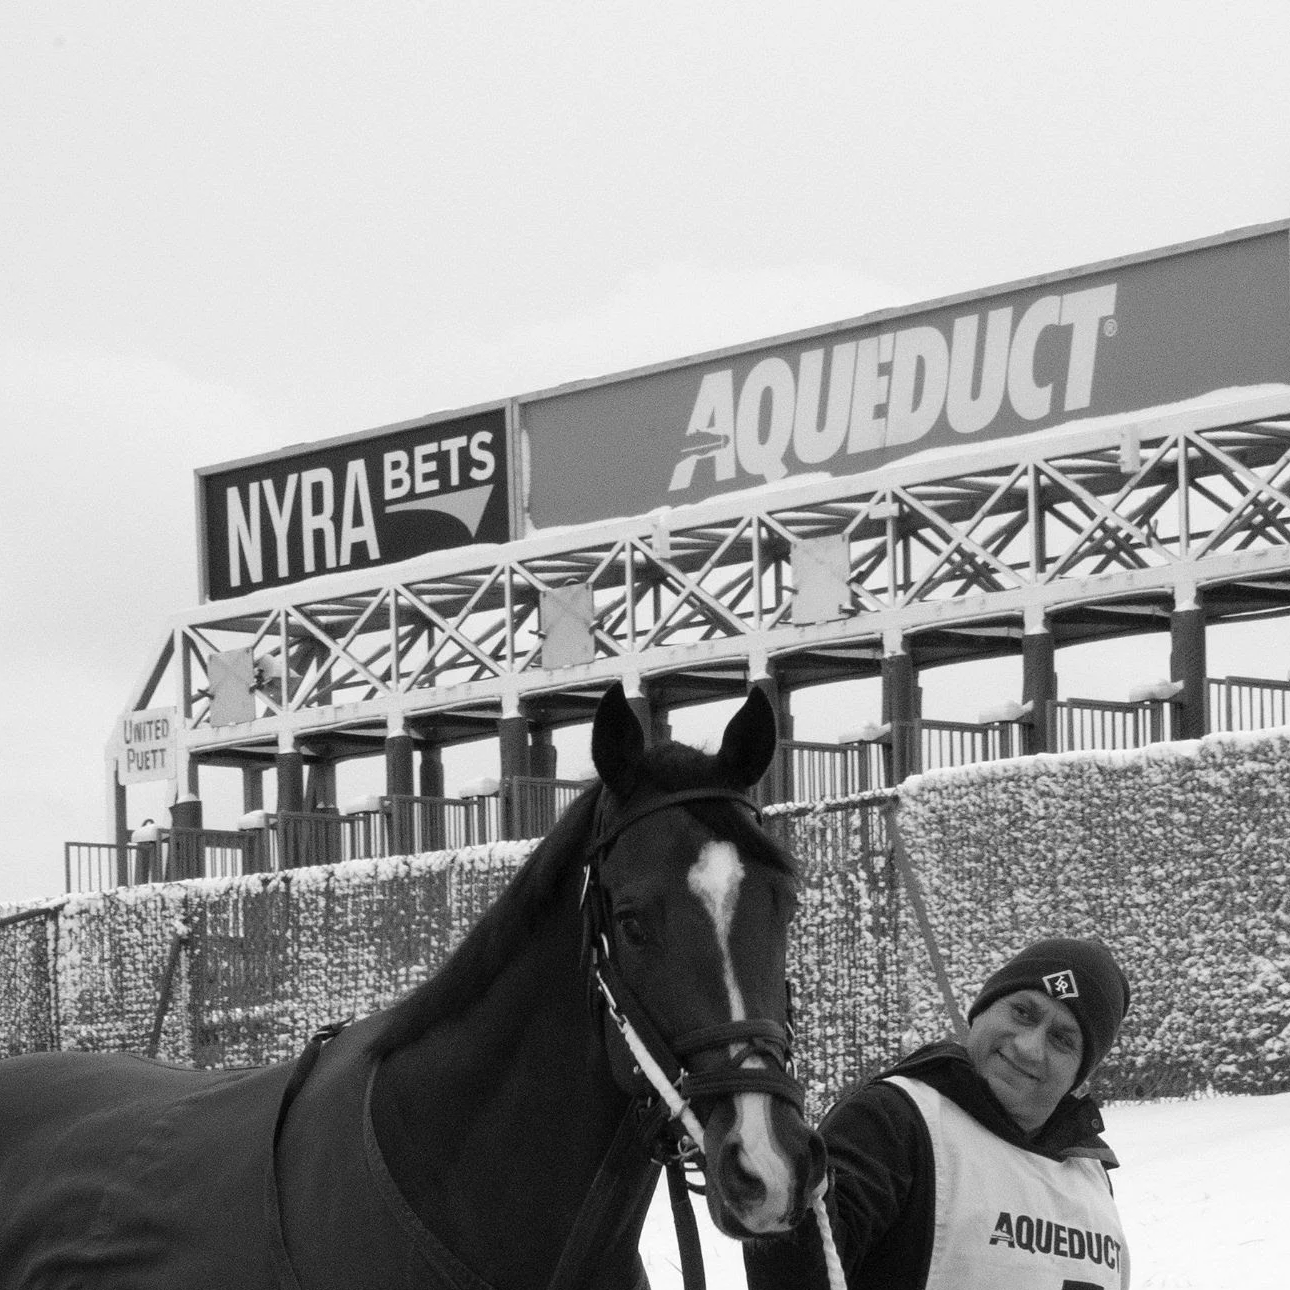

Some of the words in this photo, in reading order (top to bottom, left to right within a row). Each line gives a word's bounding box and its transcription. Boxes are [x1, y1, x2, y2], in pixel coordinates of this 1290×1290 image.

[668, 283, 1118, 492] AQUEDUCT
[226, 458, 381, 588] NYRA
[383, 431, 496, 501] BETS
[123, 718, 169, 745] UNITED
[127, 748, 166, 773] PUETT
[989, 1211, 1121, 1274] AQUEDUCT
